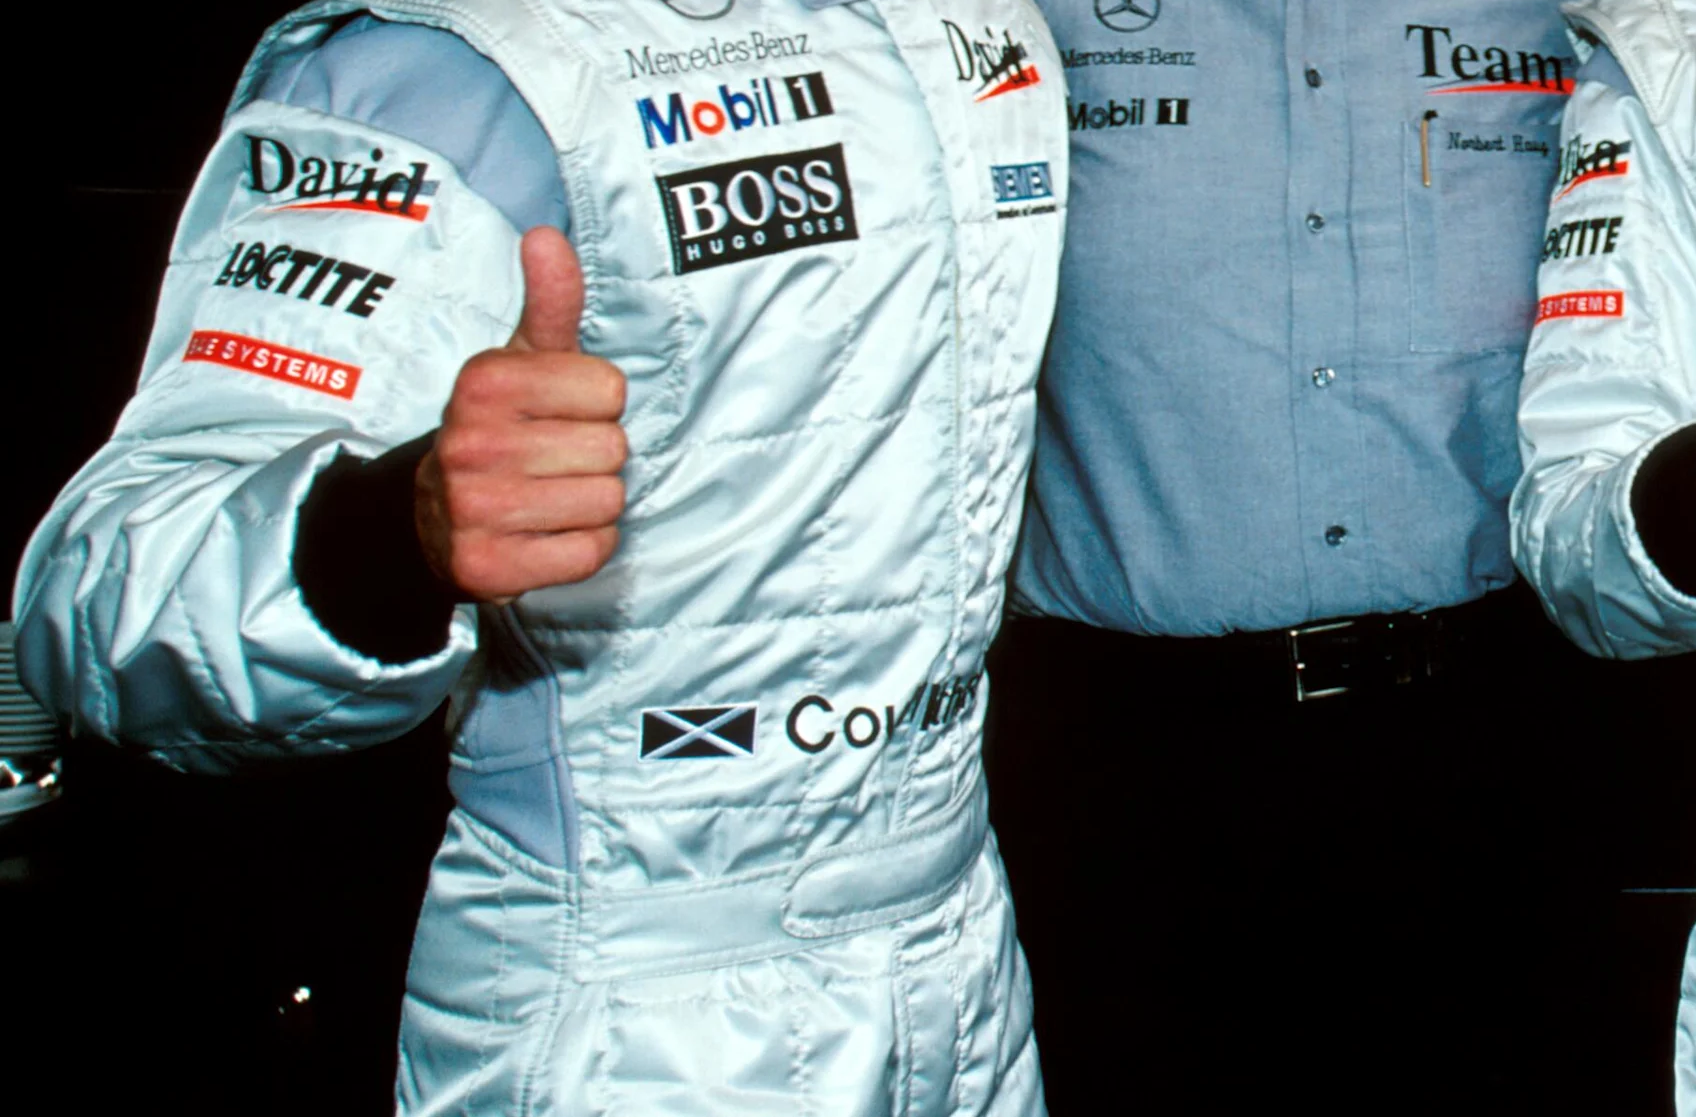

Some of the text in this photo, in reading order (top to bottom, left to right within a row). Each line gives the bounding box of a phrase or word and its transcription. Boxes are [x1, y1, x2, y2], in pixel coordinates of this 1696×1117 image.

[1405, 24, 1567, 92] Team
[637, 76, 780, 150] Mobil
[1066, 98, 1145, 131] Mobil
[245, 134, 429, 216] David
[670, 159, 842, 240] BOSS
[685, 215, 845, 262] HUGO BOSS
[213, 241, 397, 319] LOCTITE
[220, 339, 349, 391] SYSTEMS
